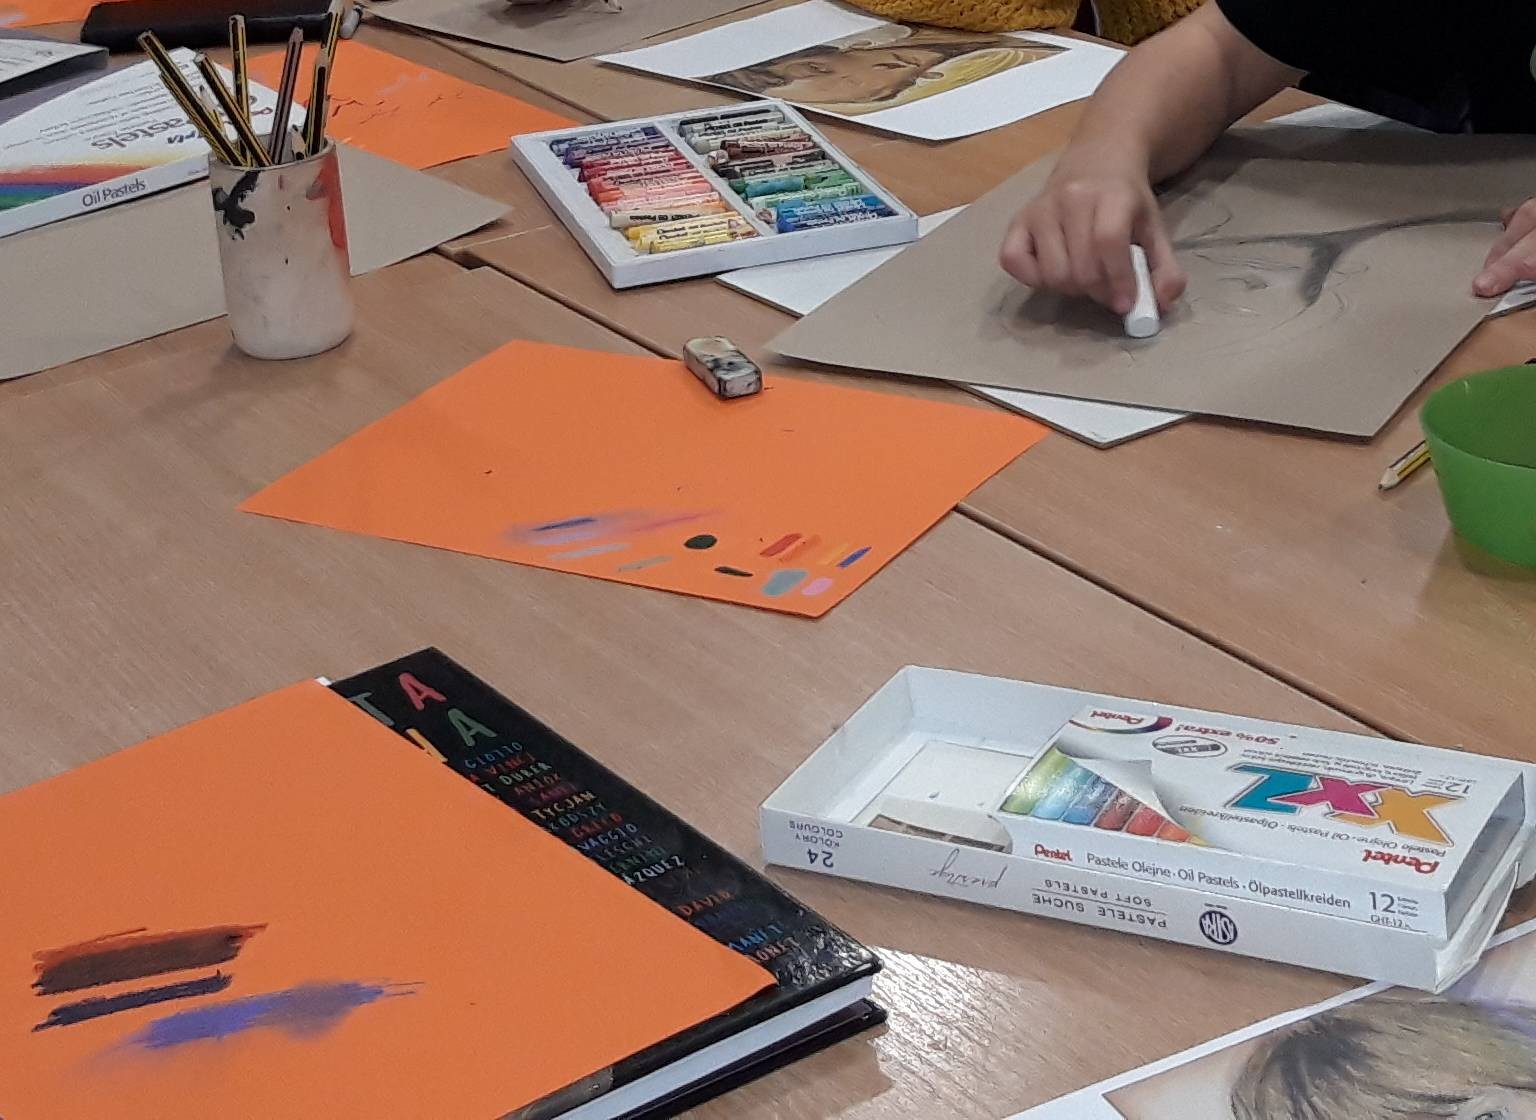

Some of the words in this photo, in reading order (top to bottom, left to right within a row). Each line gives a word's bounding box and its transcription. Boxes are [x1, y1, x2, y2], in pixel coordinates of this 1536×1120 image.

[90, 117, 188, 150] astels
[82, 189, 101, 208] Oil
[103, 178, 147, 203] Pastels
[806, 847, 835, 868] 24
[1363, 848, 1441, 875] Pentel
[1034, 843, 1073, 862] Pentel
[1087, 851, 1130, 872] Pastele
[1131, 860, 1172, 879] Olejne
[1177, 867, 1195, 881] Oil
[1198, 871, 1241, 891] Pastels
[1248, 879, 1352, 910] Ölpastellkreiden
[1369, 891, 1397, 915] 12
[1044, 879, 1109, 899] PASTELS
[1031, 892, 1086, 913] SUCHE
[1114, 894, 1152, 908] SOFT
[1097, 906, 1168, 929] PASTELE
